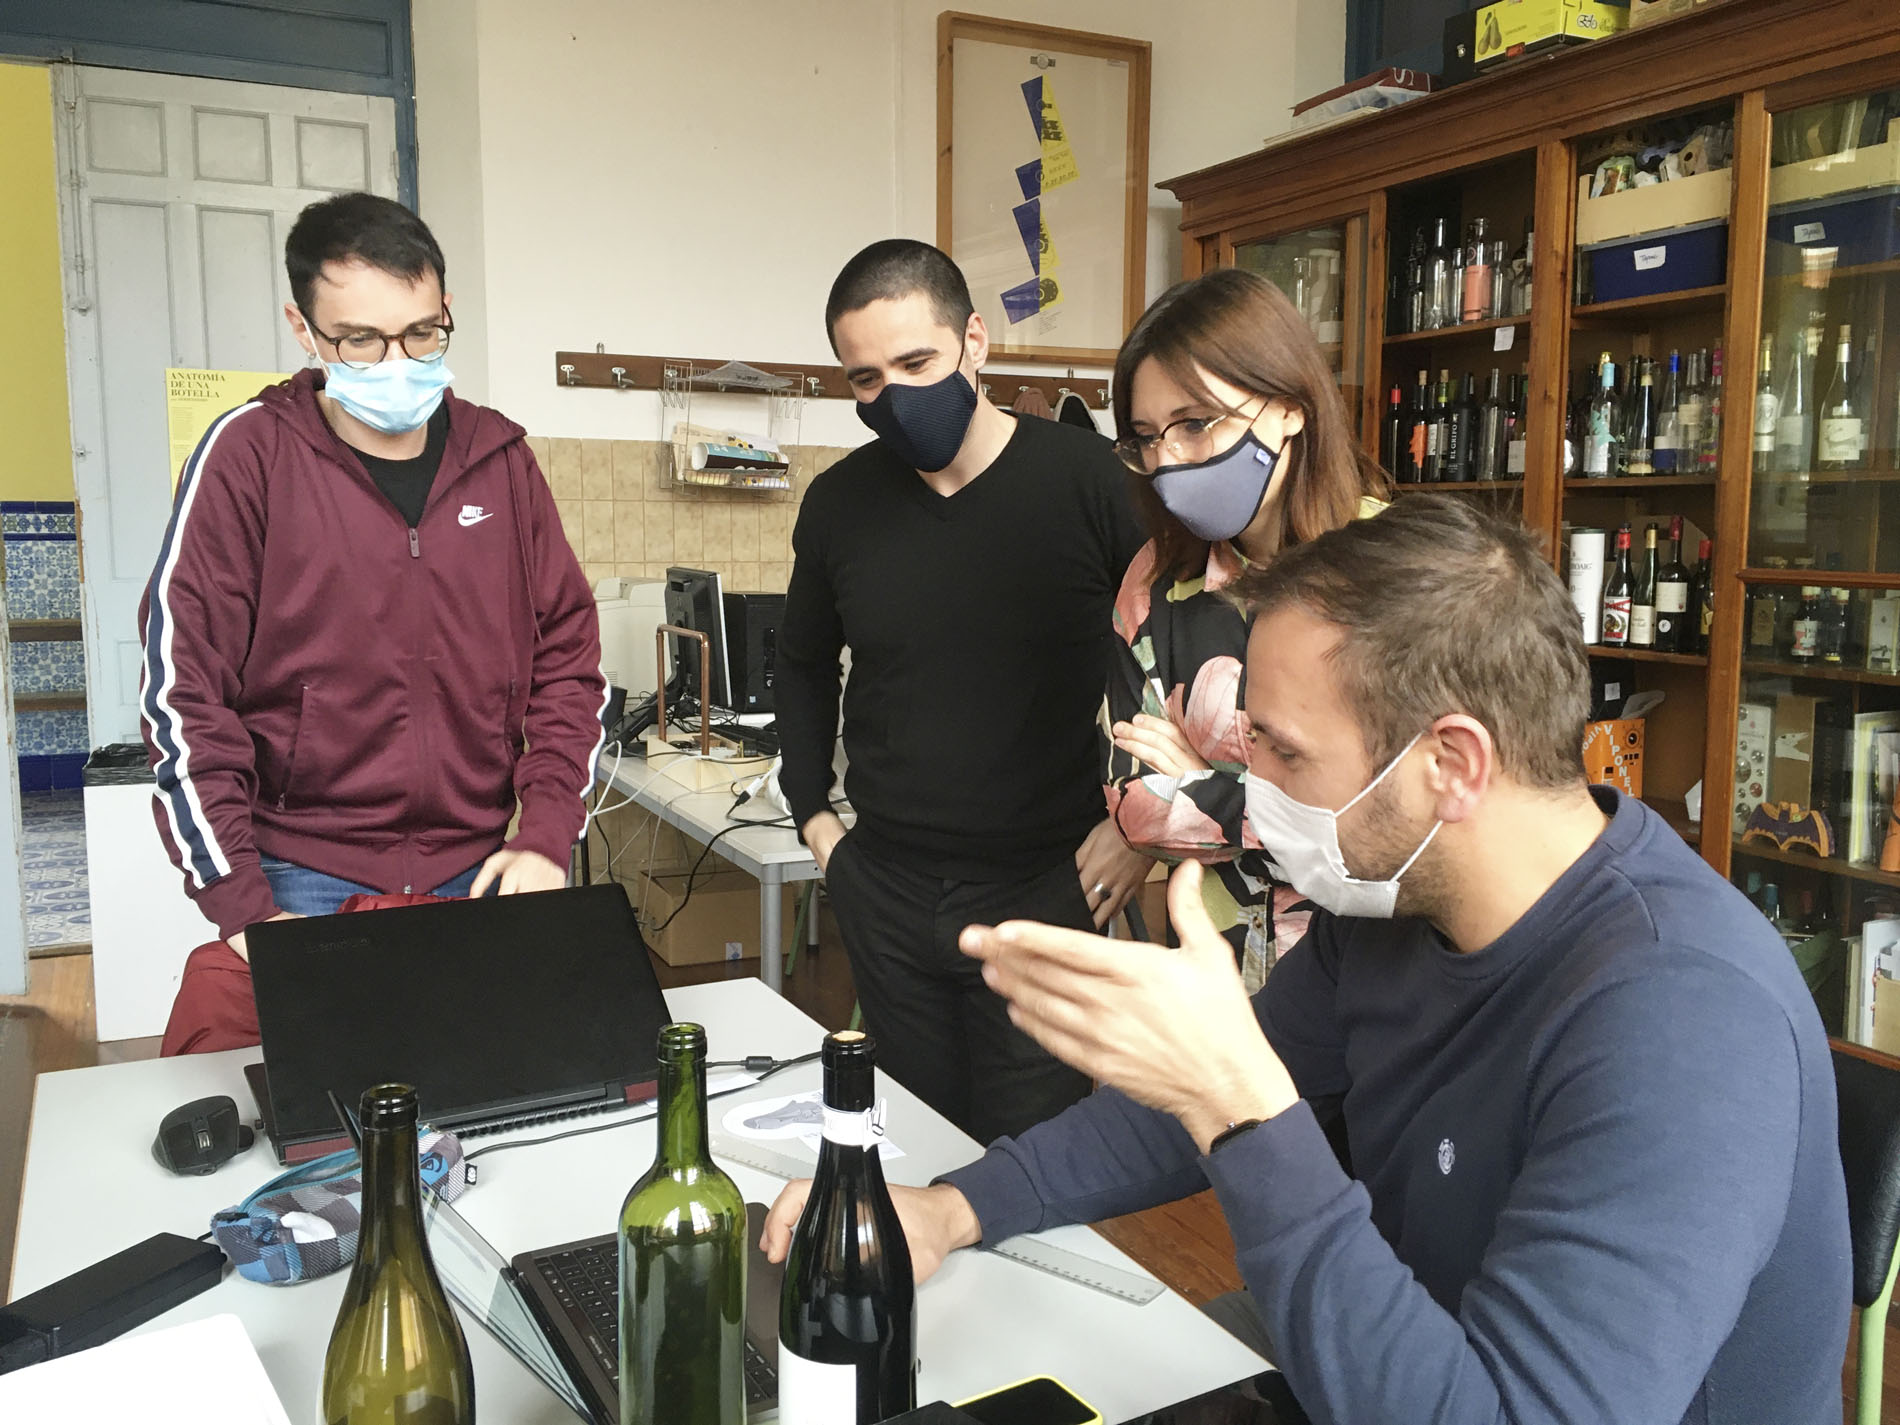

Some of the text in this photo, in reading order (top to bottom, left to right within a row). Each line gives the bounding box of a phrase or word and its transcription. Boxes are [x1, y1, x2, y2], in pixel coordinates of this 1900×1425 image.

[171, 373, 225, 382] ANATOMÍA
[187, 381, 209, 389] UNA
[171, 389, 220, 398] BOTELLA
[462, 505, 484, 518] NIKE
